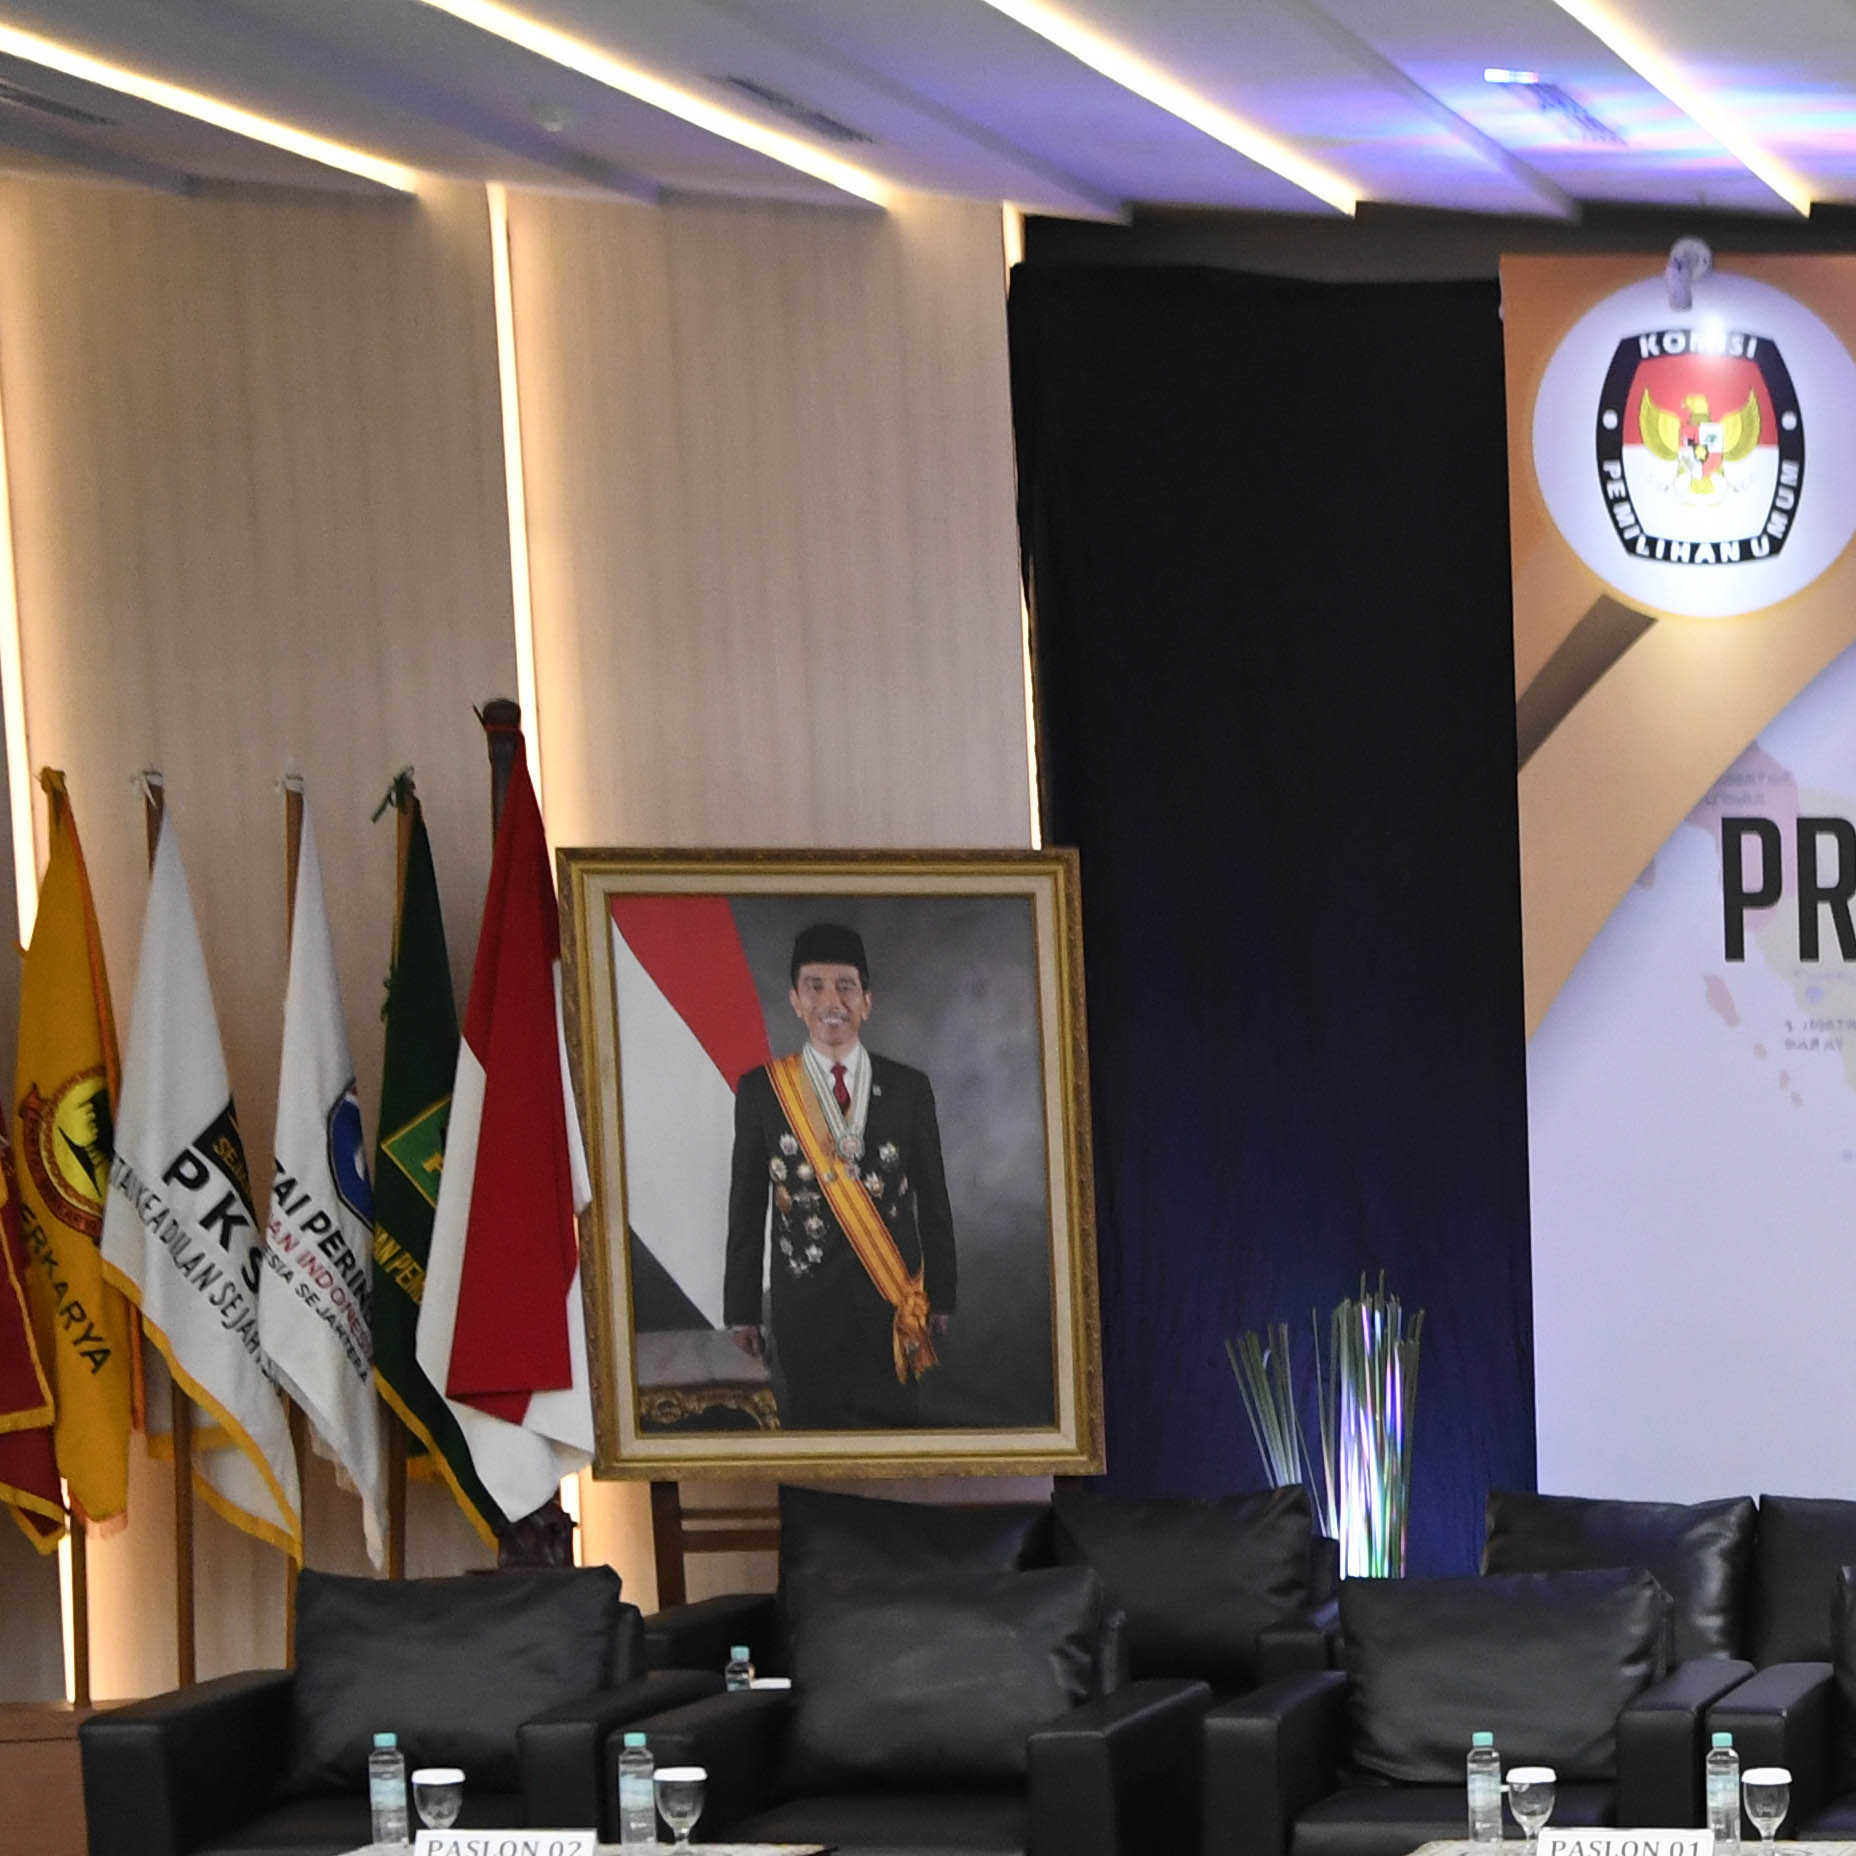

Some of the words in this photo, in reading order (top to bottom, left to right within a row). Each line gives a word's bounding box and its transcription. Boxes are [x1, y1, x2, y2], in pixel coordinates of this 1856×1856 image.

[1639, 330, 1758, 358] KOSI
[1602, 460, 1741, 563] PEMILIHAN
[1752, 460, 1800, 558] UMUM
[161, 1149, 261, 1295] PKS
